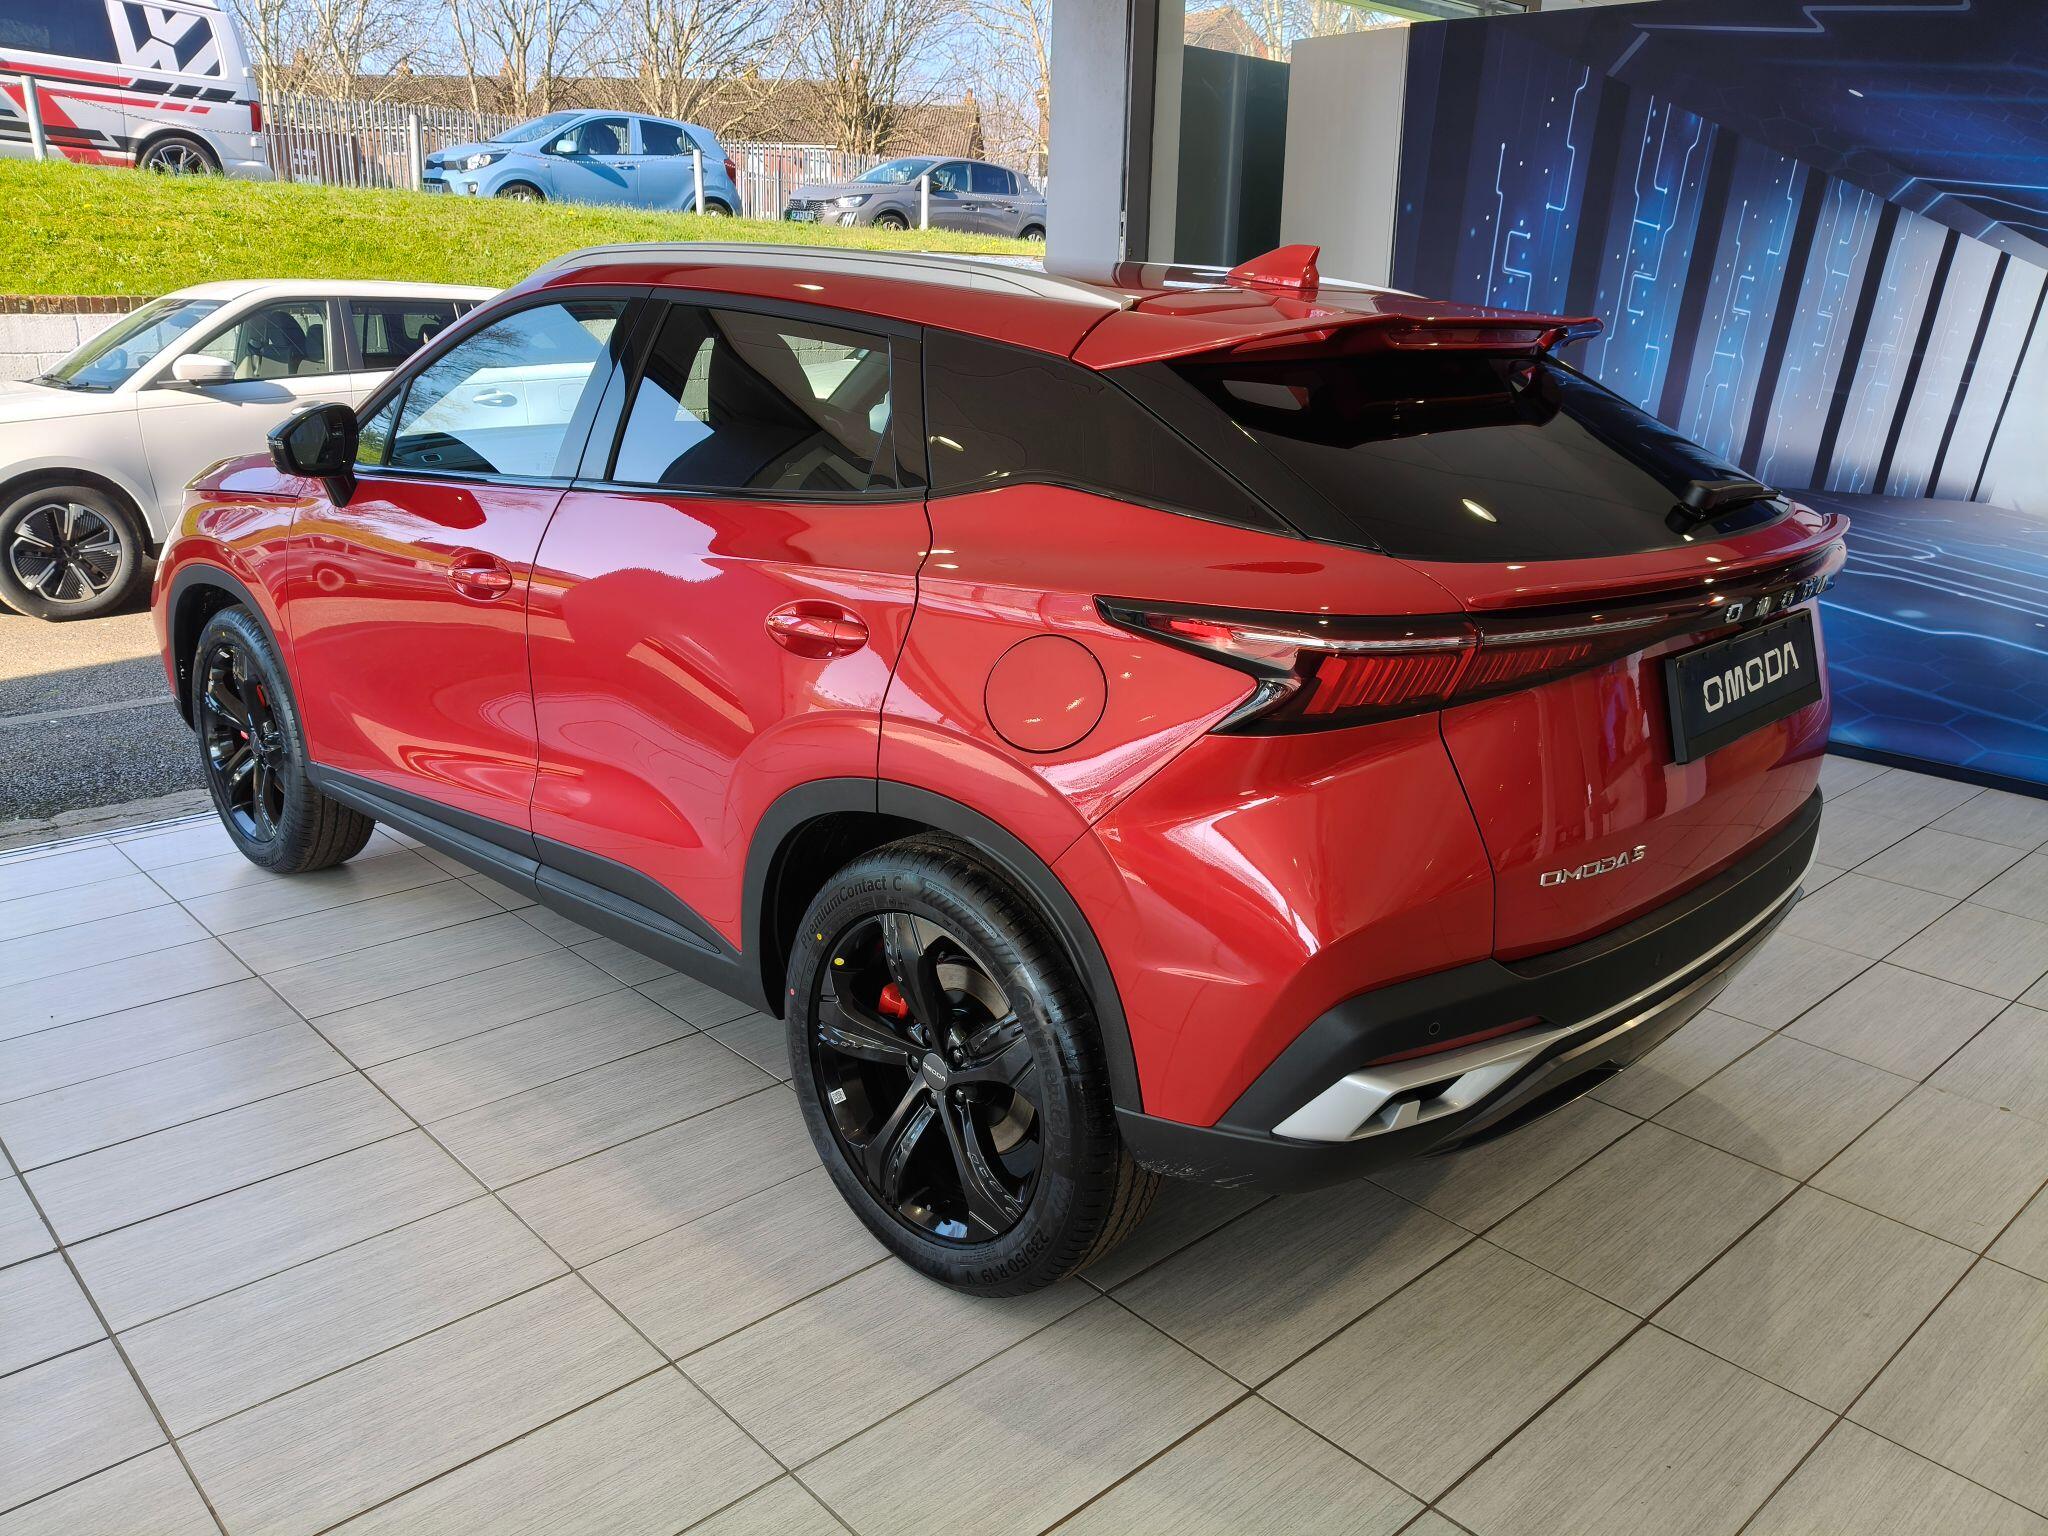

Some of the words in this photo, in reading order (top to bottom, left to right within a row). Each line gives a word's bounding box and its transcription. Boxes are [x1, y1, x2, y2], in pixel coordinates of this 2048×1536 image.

[1702, 641, 1800, 713] OMODA
[1540, 851, 1629, 888] OMODA
[800, 875, 888, 950] PremiumContact
